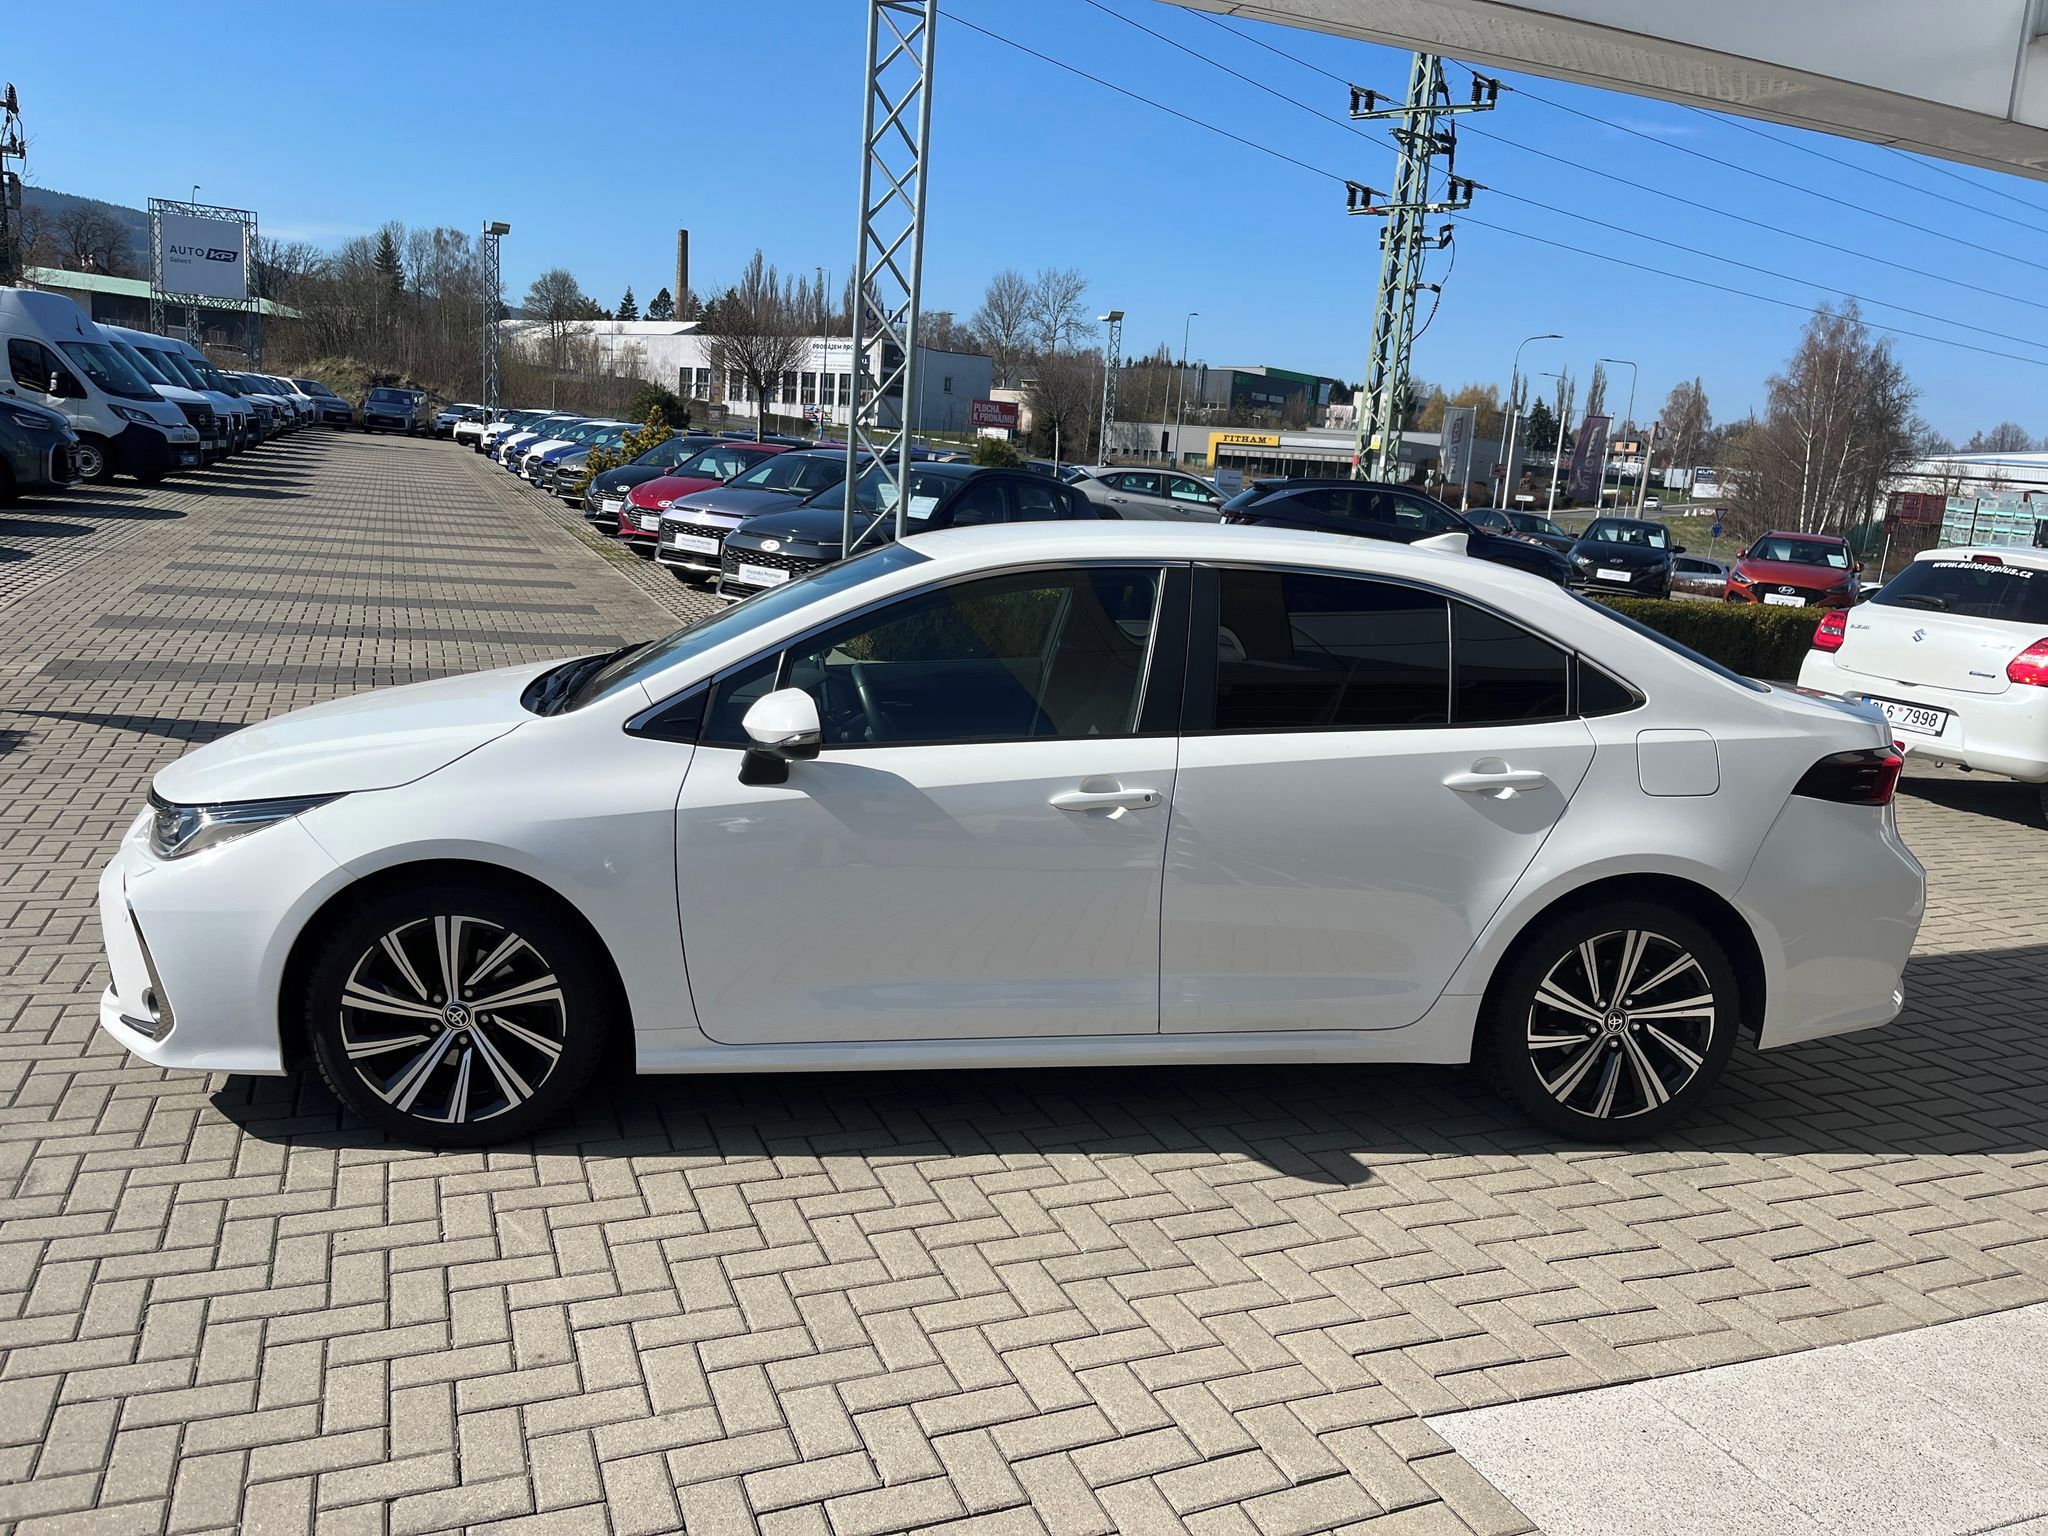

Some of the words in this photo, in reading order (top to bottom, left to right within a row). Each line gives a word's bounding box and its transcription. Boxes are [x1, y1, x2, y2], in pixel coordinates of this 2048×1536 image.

[170, 245, 204, 257] AUTO
[812, 343, 842, 351] PROÁJEM
[974, 403, 1000, 413] PLOCHA
[1223, 434, 1267, 444] FITHAM
[1932, 561, 2034, 579] www.autokpplus.cz
[1902, 708, 1939, 727] 7998
